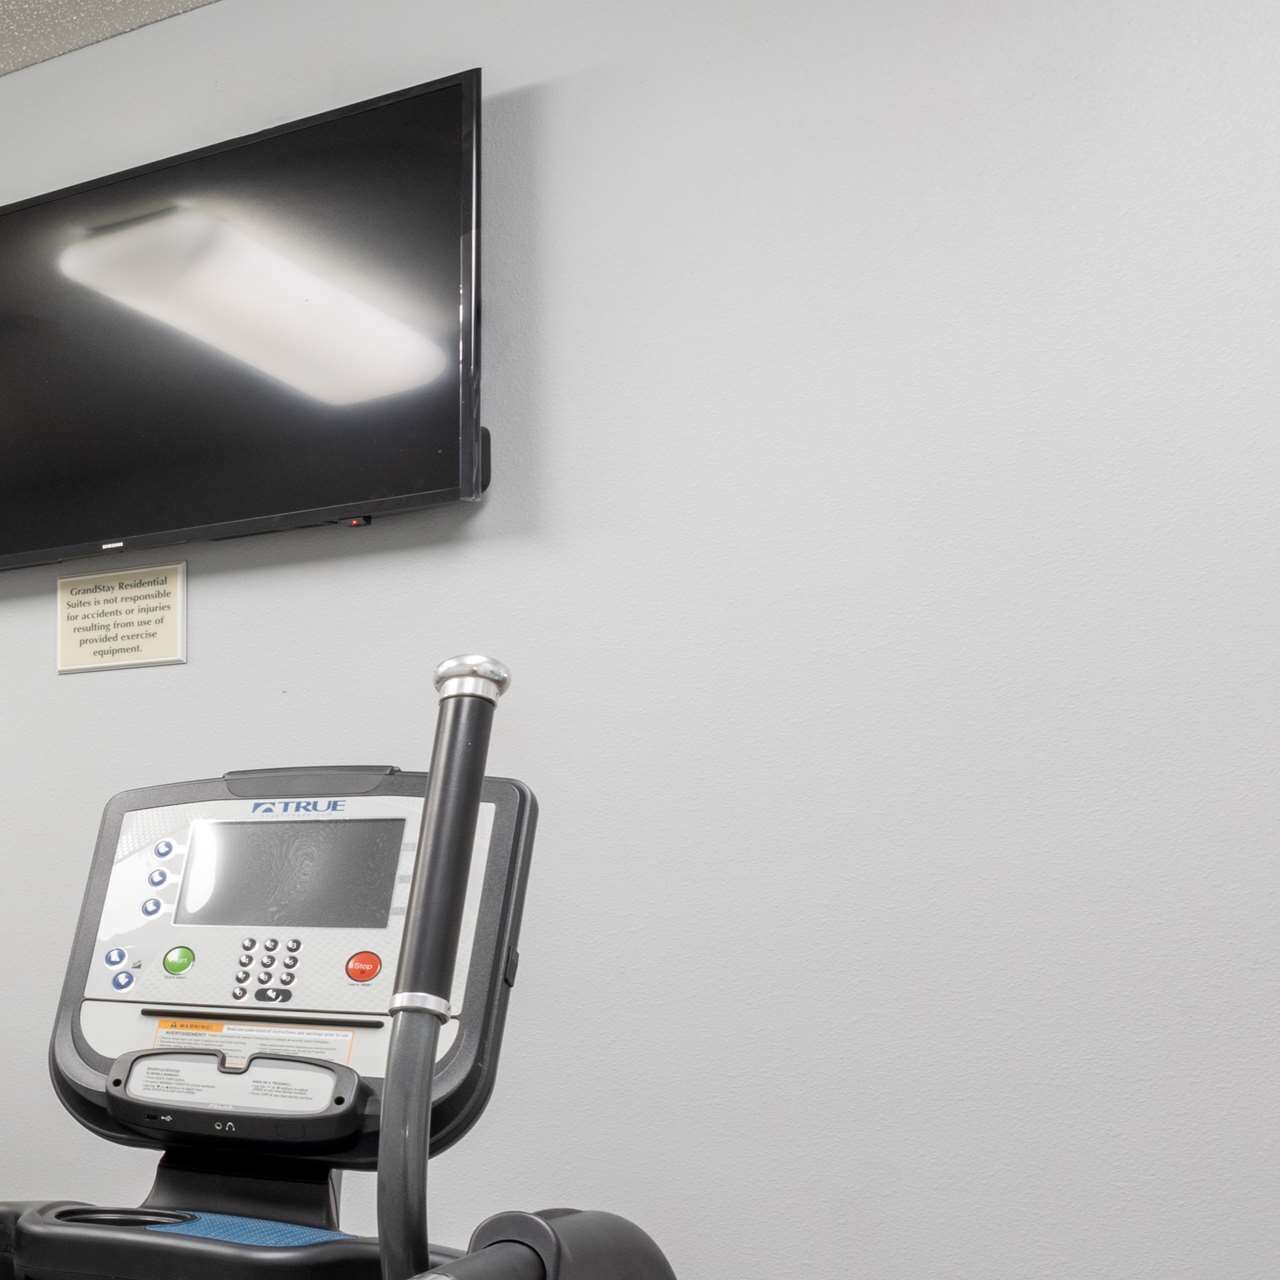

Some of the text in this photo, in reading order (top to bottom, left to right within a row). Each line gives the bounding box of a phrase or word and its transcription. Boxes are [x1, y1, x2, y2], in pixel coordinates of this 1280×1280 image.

[70, 576, 168, 596] GrandStay Residential
[66, 599, 92, 609] Suites
[94, 598, 100, 606] is
[121, 590, 172, 604] responsible
[66, 613, 79, 621] for
[81, 609, 122, 620] accidents
[137, 603, 171, 615] injuries
[73, 622, 111, 633] resulting
[113, 620, 135, 629] from
[155, 616, 164, 625] of
[80, 630, 158, 647] provided exercise
[93, 645, 143, 658] equipment.
[278, 800, 346, 812] TRUE
[354, 962, 373, 971] Stop
